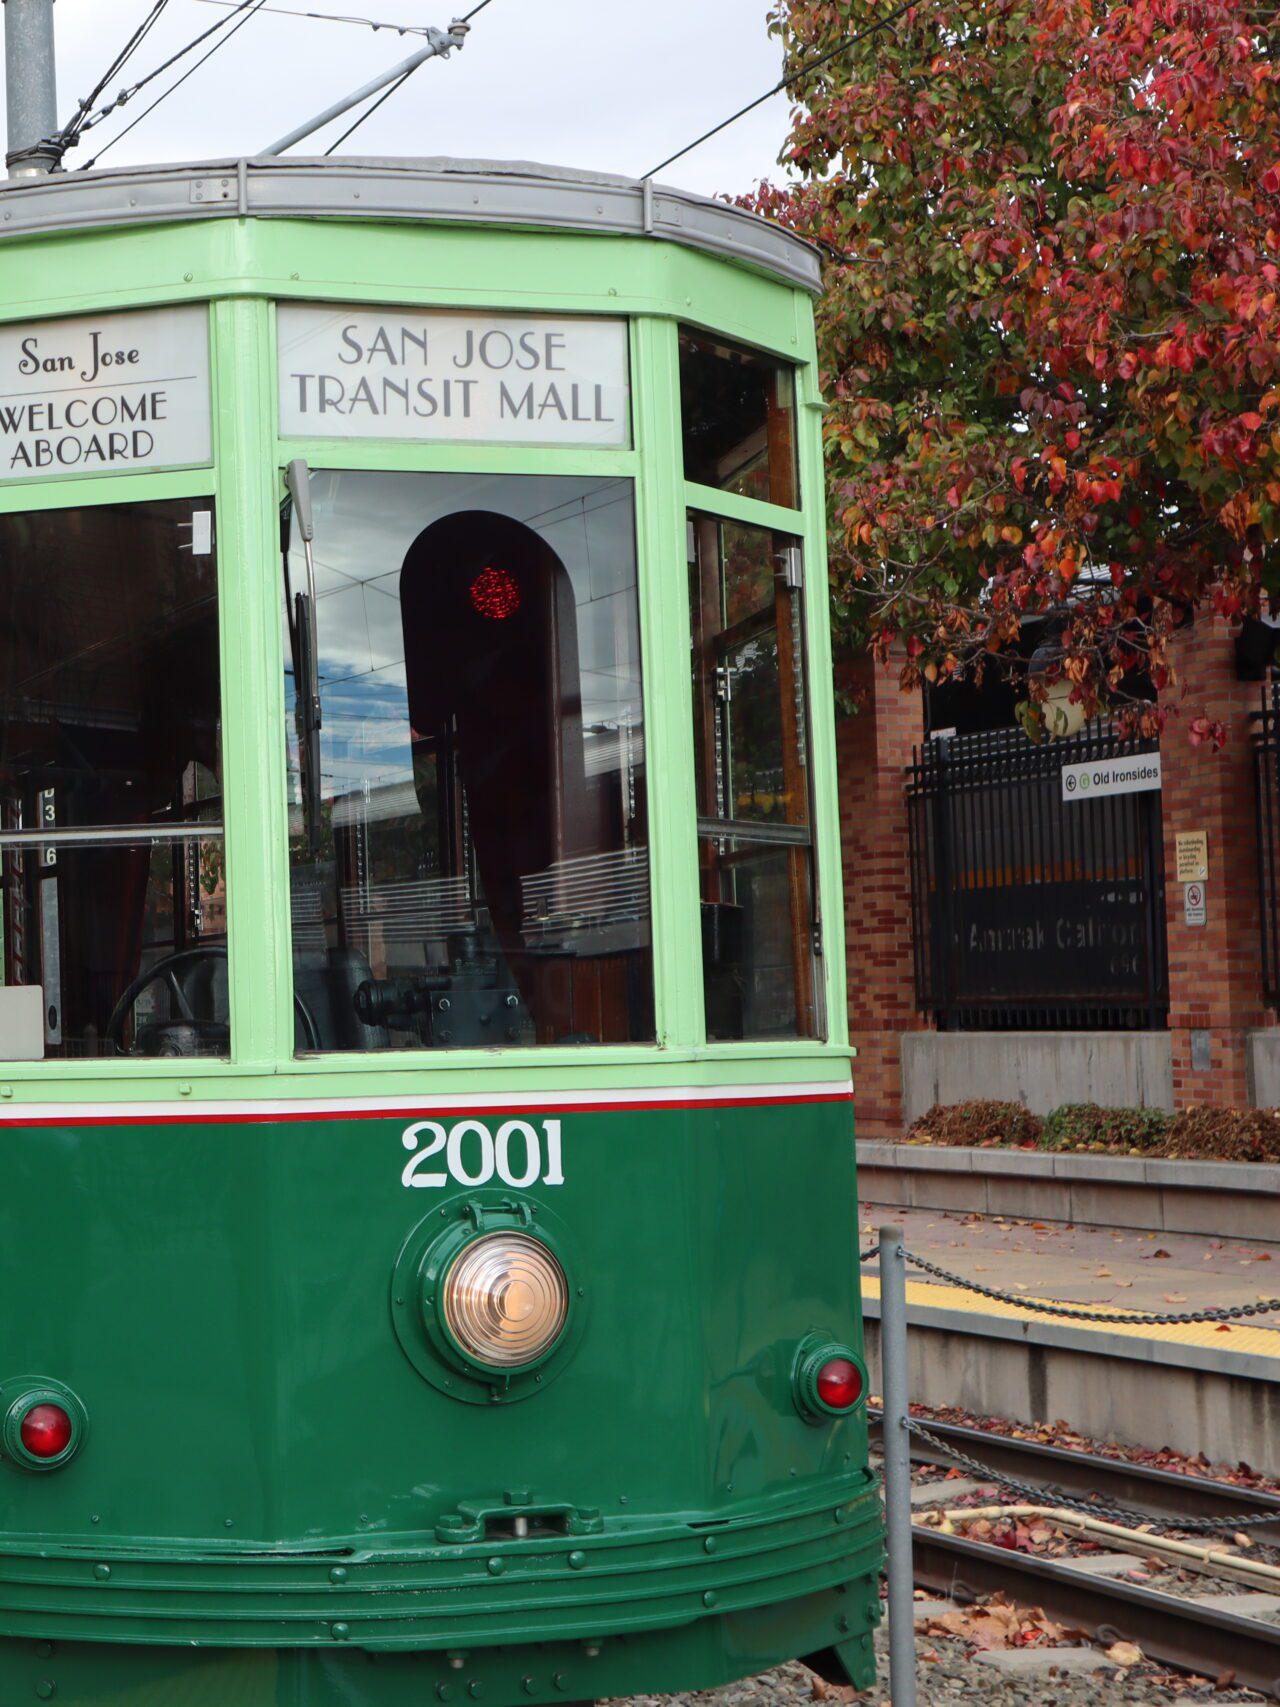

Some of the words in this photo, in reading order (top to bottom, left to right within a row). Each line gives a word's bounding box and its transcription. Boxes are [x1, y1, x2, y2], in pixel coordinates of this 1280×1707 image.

[18, 337, 75, 376] San
[80, 331, 140, 383] Jose
[337, 324, 428, 366] SAN
[452, 329, 567, 371] JOSE
[289, 373, 479, 418] TRANSIT
[499, 379, 615, 422] MALL
[10, 430, 154, 469] ABOARD
[1092, 771, 1110, 786] Old
[1112, 766, 1159, 783] Ironsides
[44, 804, 56, 821] 3
[46, 847, 57, 865] 6
[401, 1119, 565, 1188] 2001
